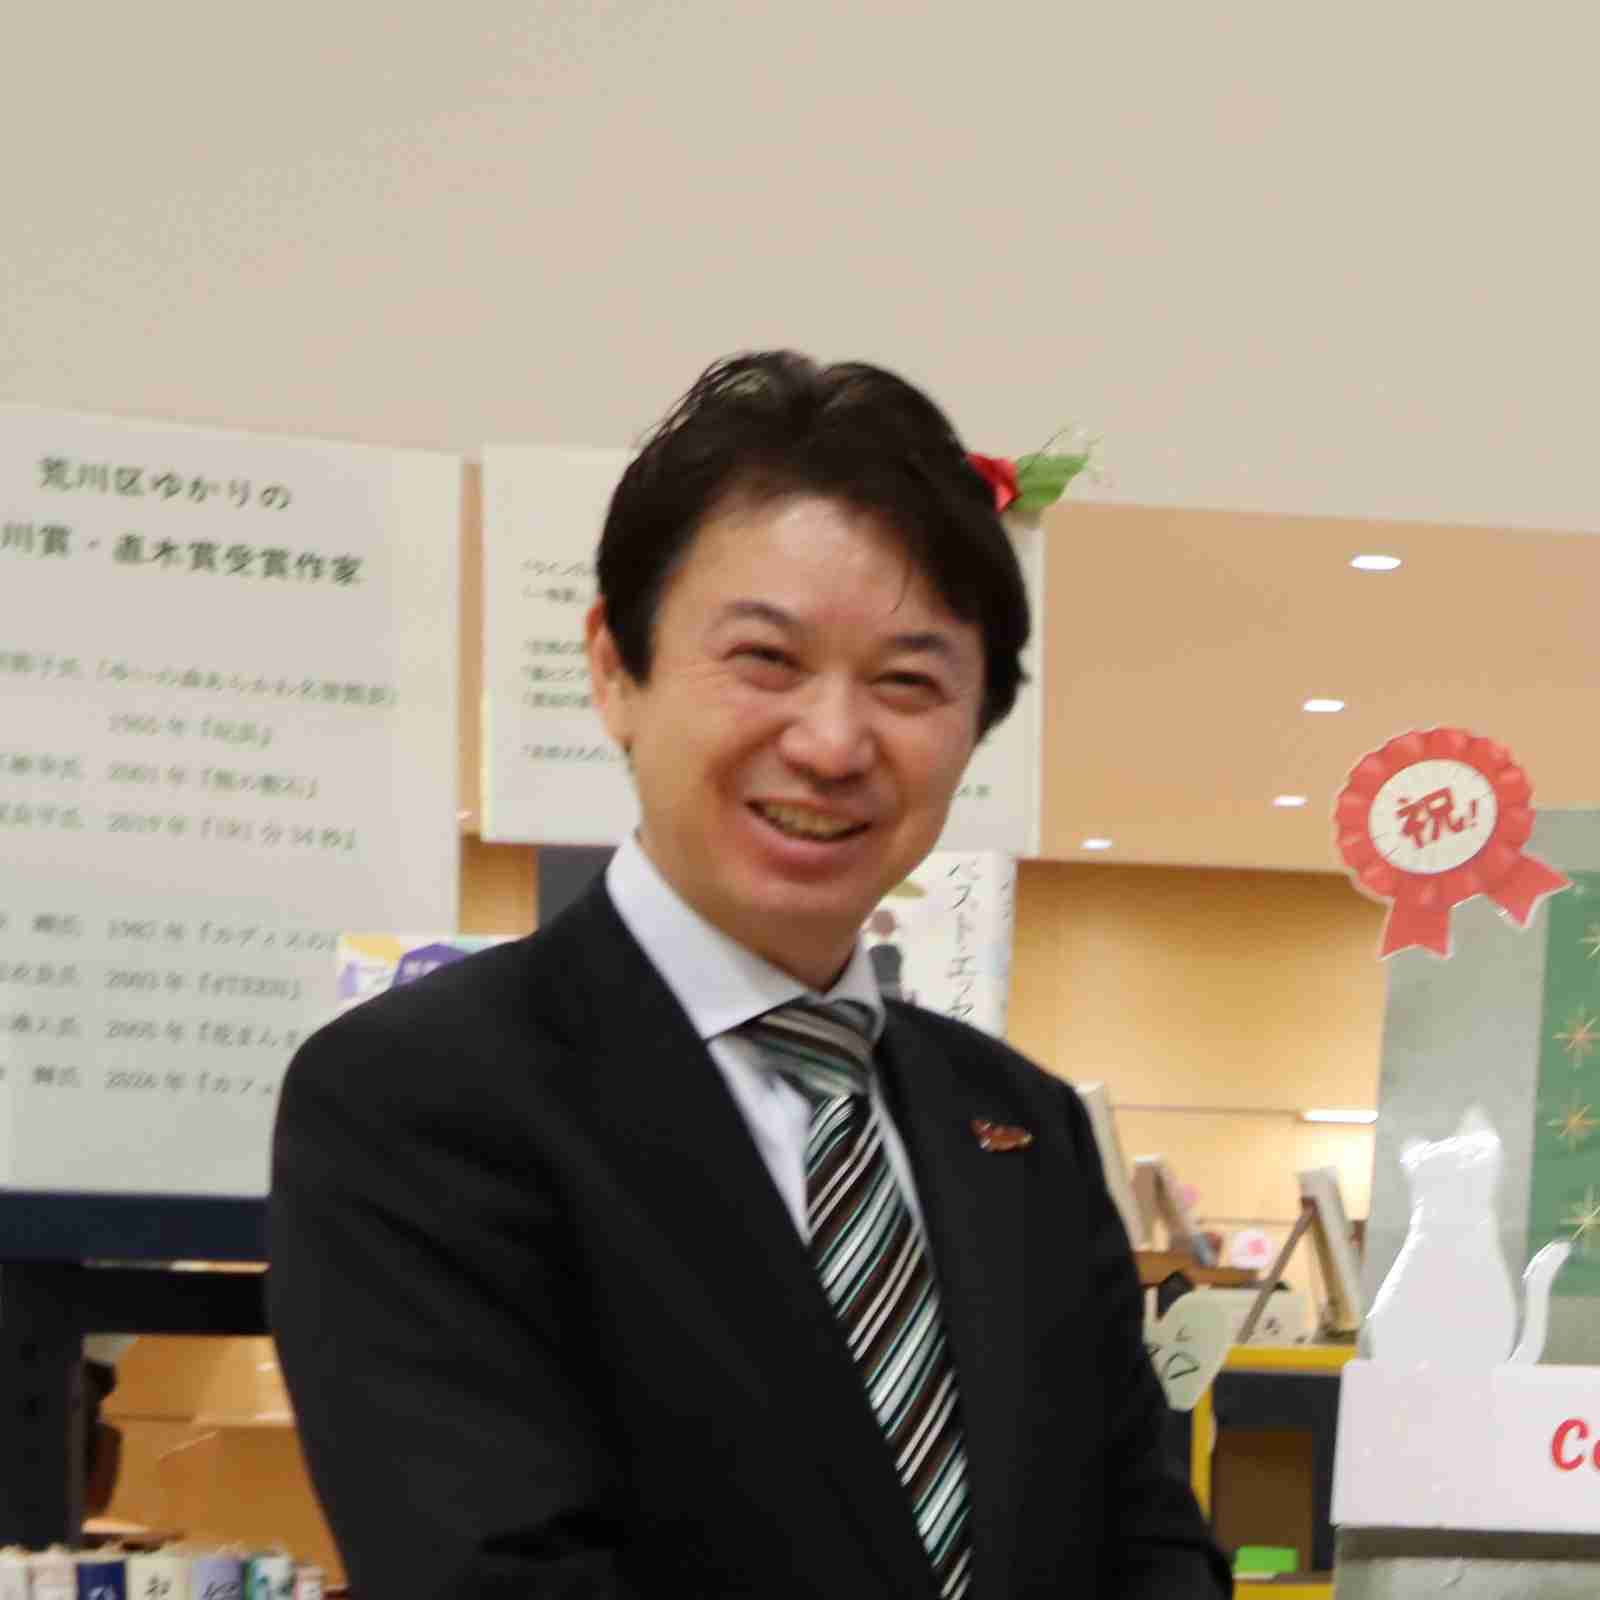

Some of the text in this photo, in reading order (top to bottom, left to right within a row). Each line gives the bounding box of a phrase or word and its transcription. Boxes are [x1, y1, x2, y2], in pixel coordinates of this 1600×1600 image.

[38, 455, 293, 510] 荒川区ゆかりの
